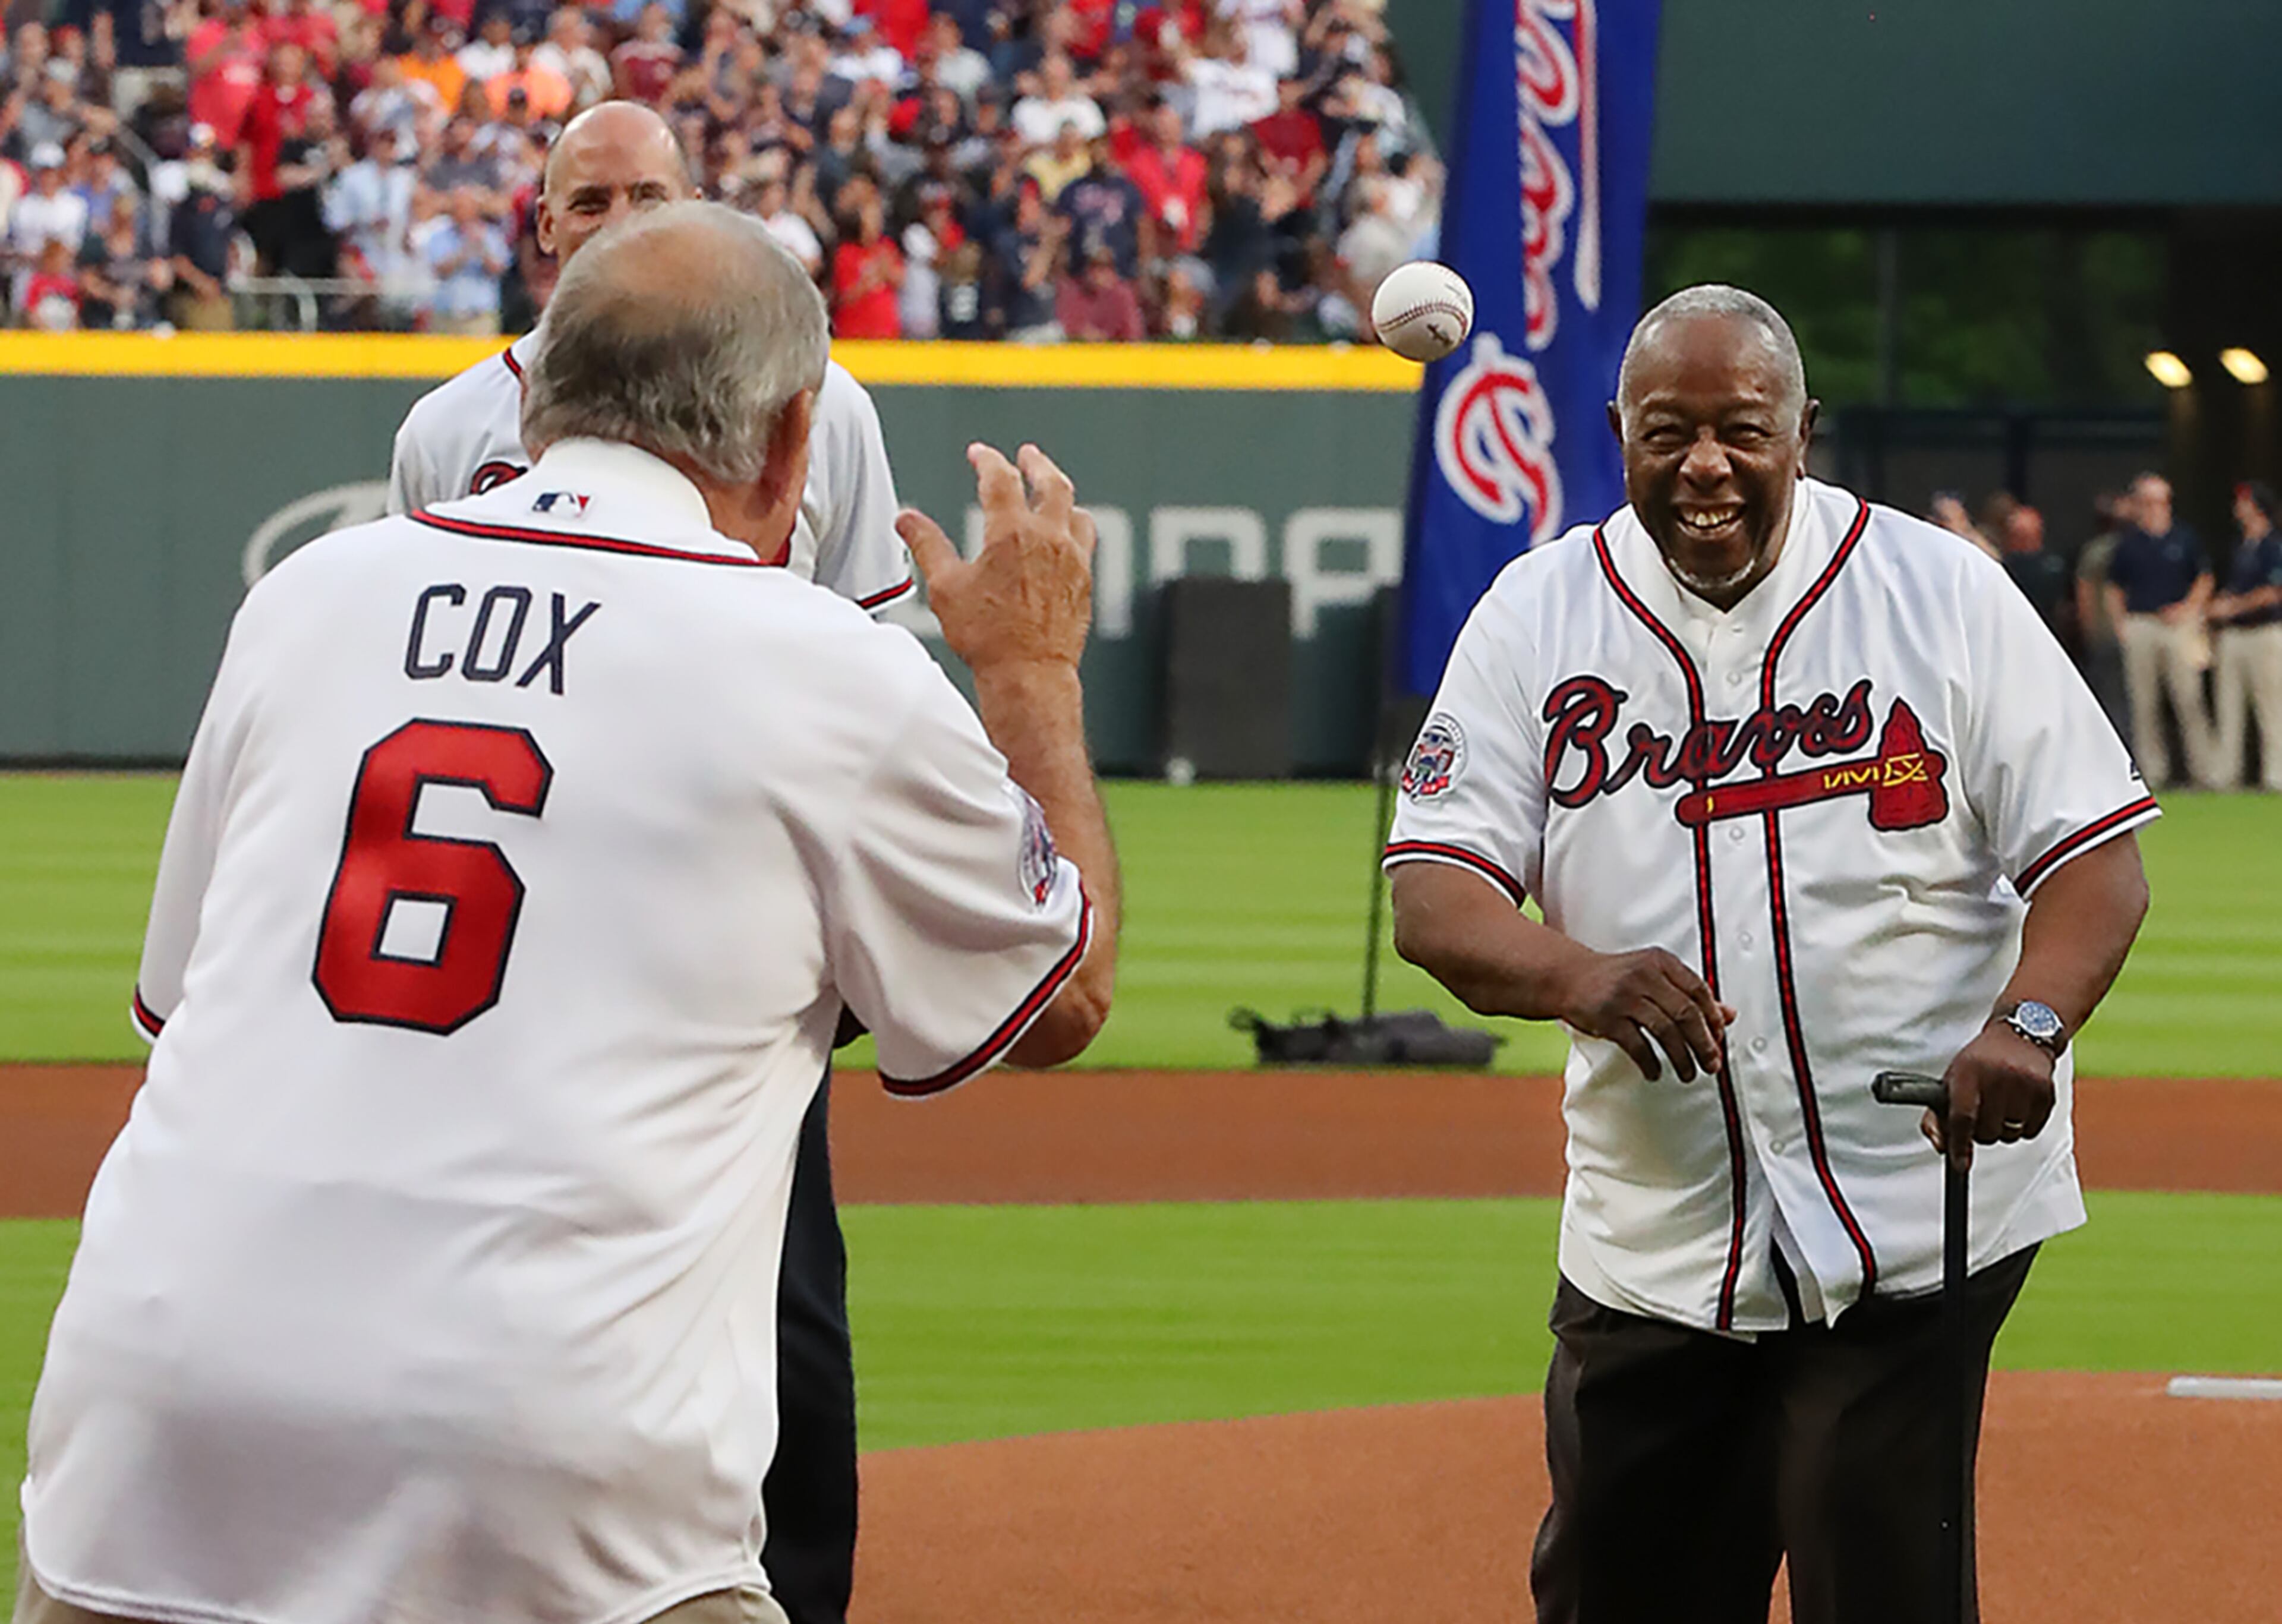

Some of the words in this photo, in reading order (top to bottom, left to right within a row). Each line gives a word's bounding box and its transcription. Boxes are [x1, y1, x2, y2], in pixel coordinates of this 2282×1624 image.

[405, 584, 601, 696] COX
[1543, 674, 1873, 808] Braves
[312, 717, 554, 1036] 6
